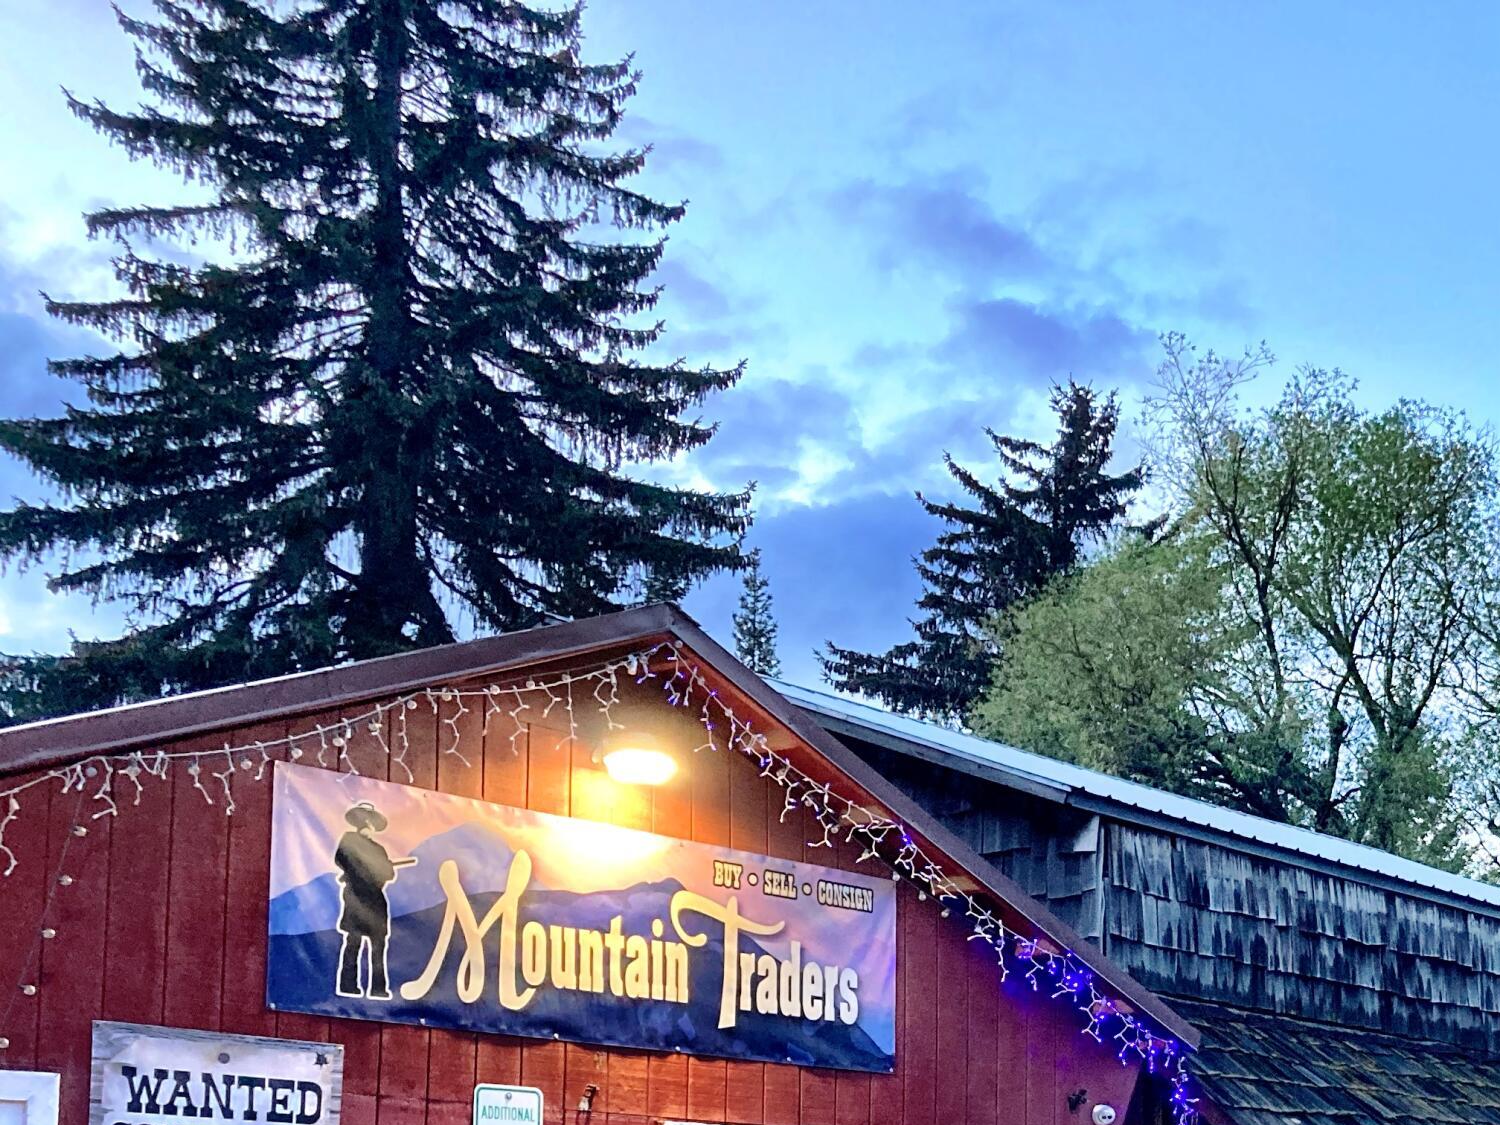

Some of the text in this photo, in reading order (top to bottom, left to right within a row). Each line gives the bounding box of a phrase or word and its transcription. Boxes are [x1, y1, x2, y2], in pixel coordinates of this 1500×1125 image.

[713, 860, 873, 913] BUY SELL CONSIGN
[401, 849, 859, 1029] Mountain Traders
[121, 1066, 323, 1125] WANTED
[481, 1105, 535, 1122] ADDITIONAL
